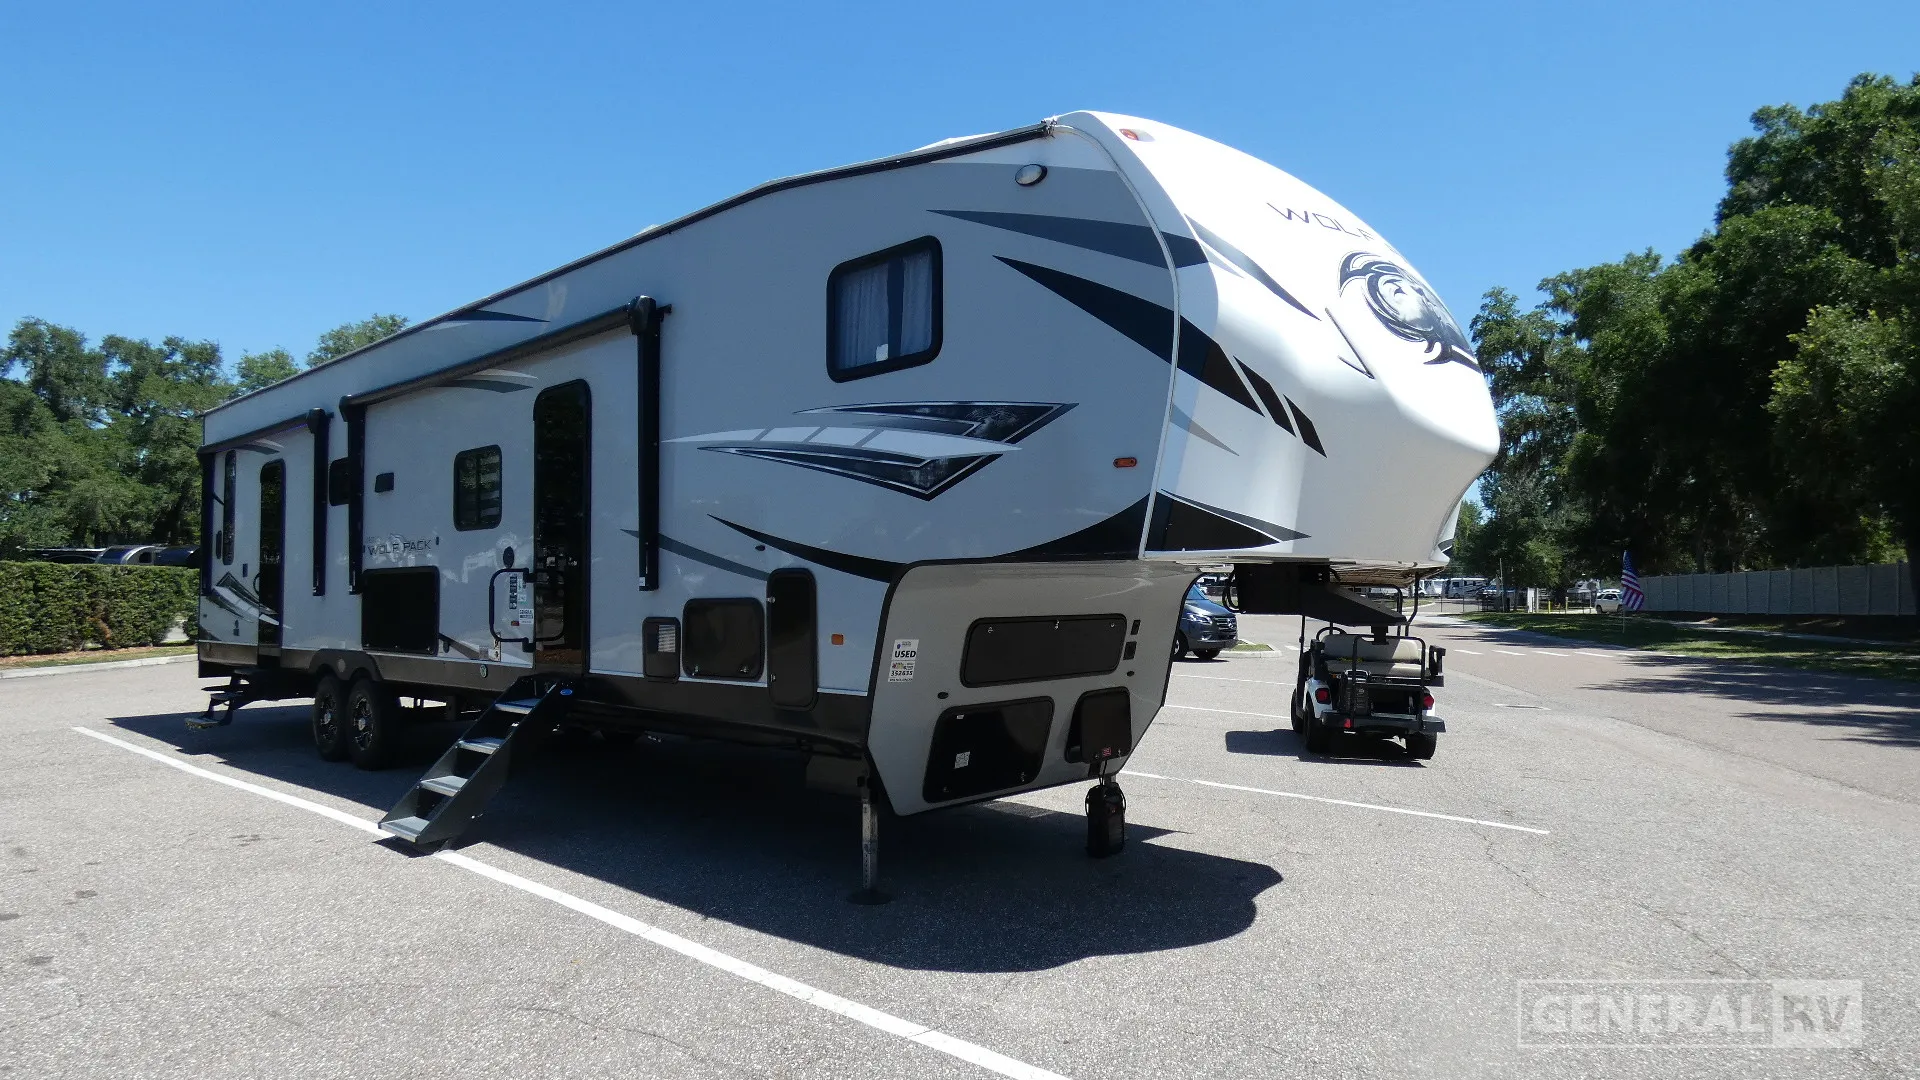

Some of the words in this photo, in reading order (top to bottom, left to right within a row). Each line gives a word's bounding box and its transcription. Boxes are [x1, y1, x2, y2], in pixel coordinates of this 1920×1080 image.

[1266, 202, 1375, 241] WOLF
[367, 543, 399, 555] WOLF
[403, 539, 432, 552] PACK
[894, 650, 916, 658] USED
